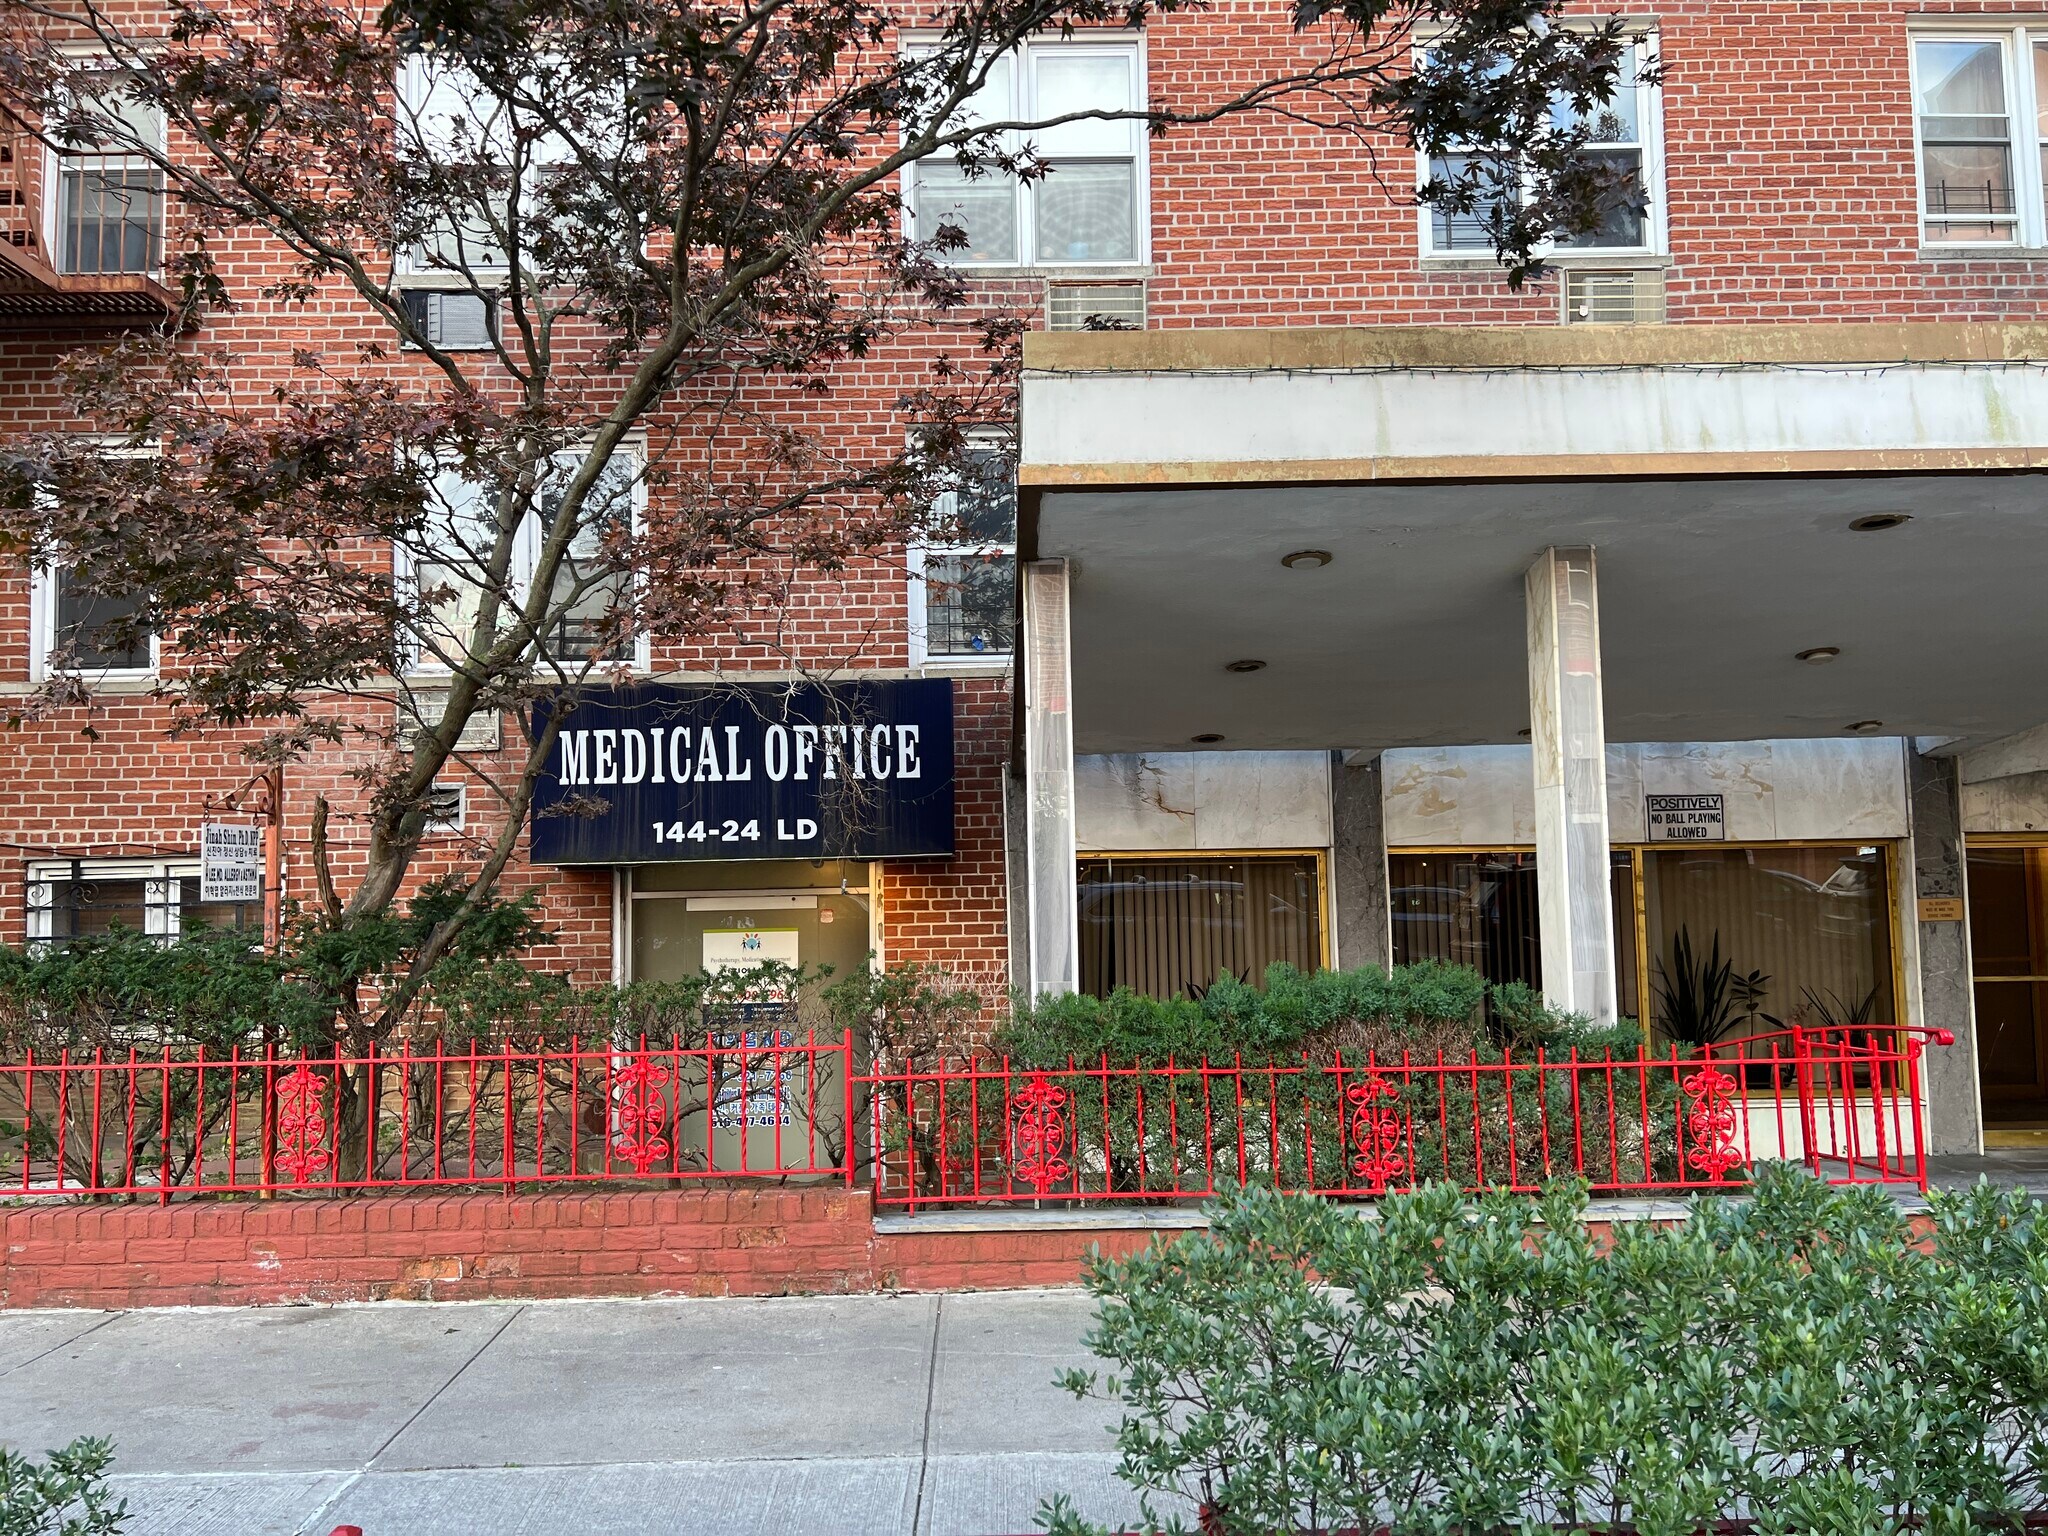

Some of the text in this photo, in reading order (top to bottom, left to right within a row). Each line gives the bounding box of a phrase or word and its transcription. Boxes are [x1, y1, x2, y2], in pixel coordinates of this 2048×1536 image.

[558, 723, 921, 786] MEDICAL OFFICE
[1651, 797, 1719, 809] POSITIVELY
[1651, 813, 1721, 824] NO BALL PLAYING
[206, 828, 222, 844] Jinah
[652, 818, 818, 844] 144-24 LD
[1667, 827, 1707, 838] ALLOWED
[223, 846, 233, 857] 정신
